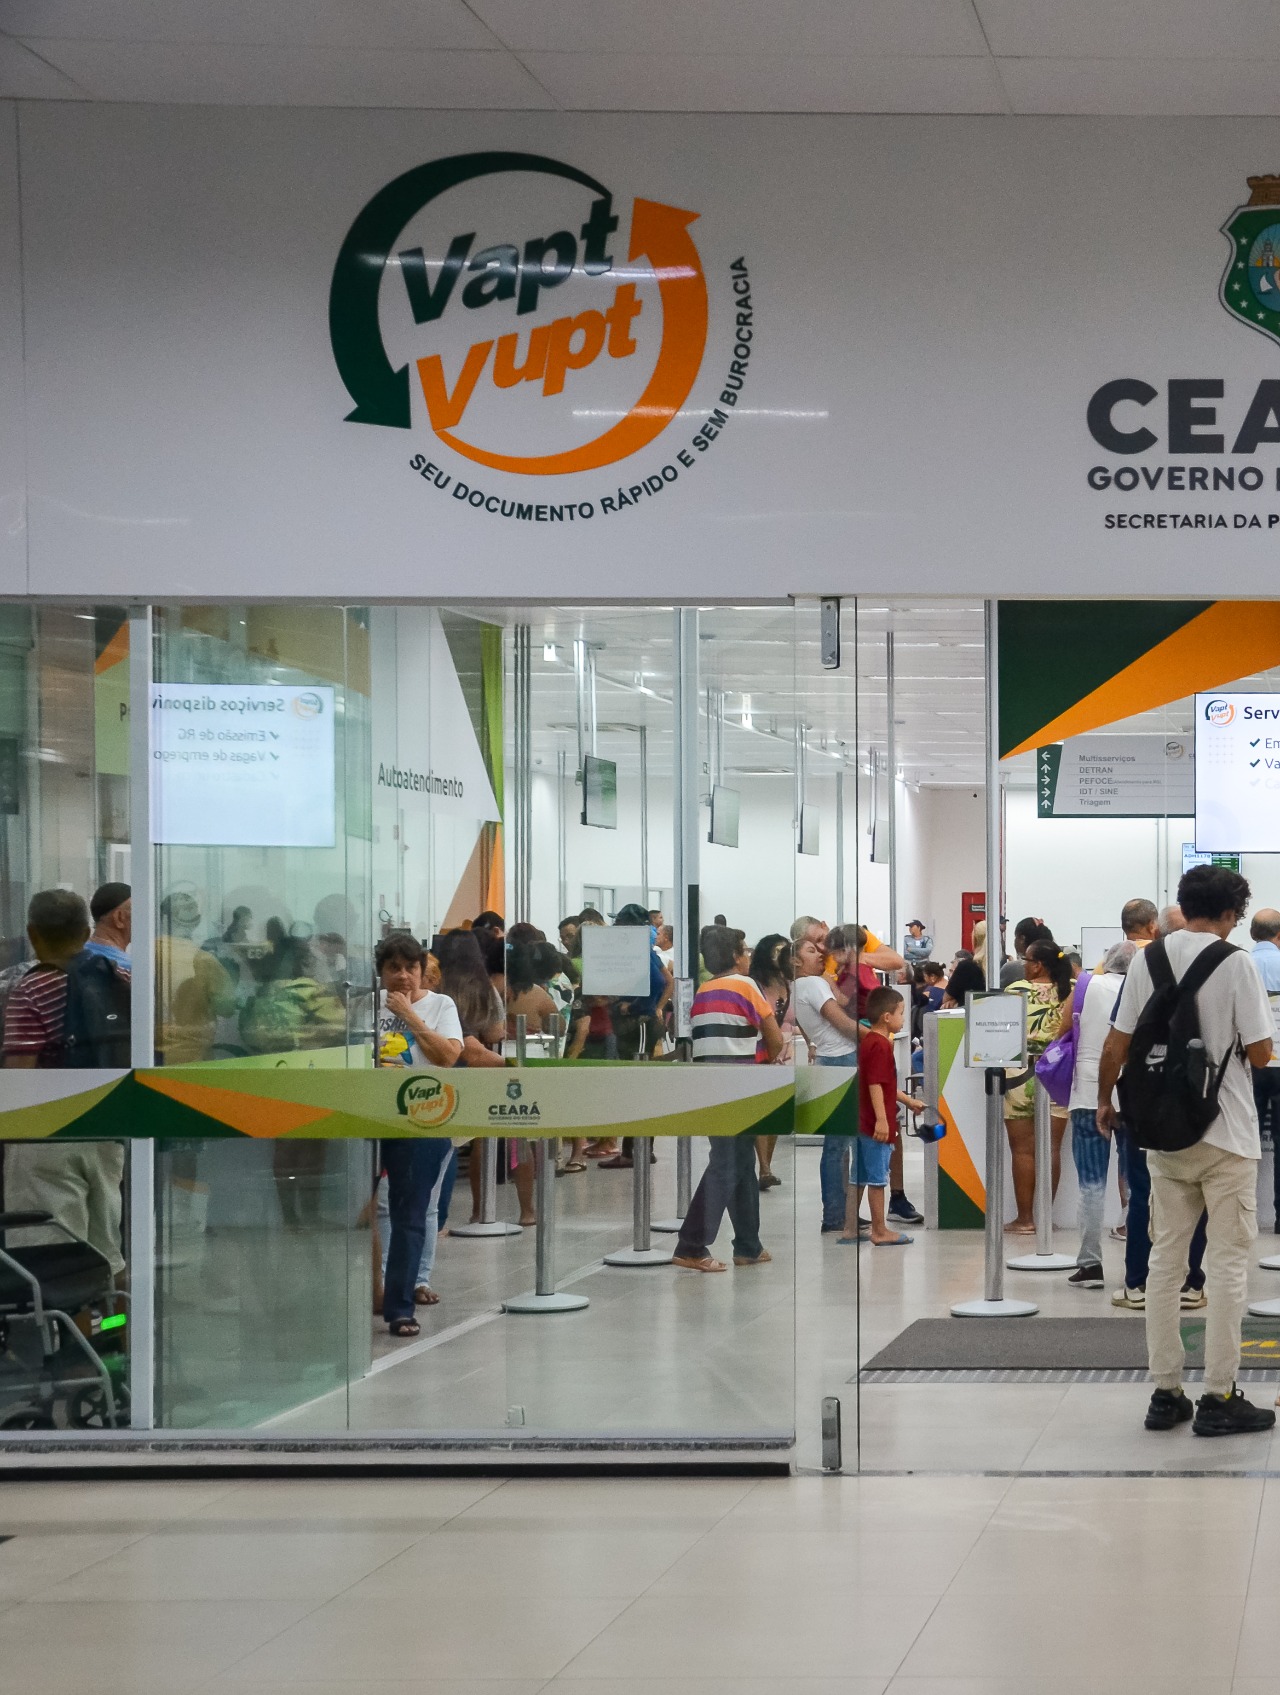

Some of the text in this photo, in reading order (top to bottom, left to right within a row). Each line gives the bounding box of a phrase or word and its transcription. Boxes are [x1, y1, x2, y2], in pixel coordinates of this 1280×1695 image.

[399, 195, 619, 325] Vapt
[416, 282, 643, 431] Vupt
[409, 256, 754, 522] SEU DOCUMENTO RÁPIDO E SEM BUROCRACIA
[1087, 466, 1264, 492] GOVERNO
[1104, 514, 1228, 529] SECRETARIA
[1233, 514, 1262, 529] DA
[1079, 754, 1136, 762] Multisserviços
[378, 762, 464, 798] Autoatendimento
[1079, 777, 1112, 785] PEFOCE
[1080, 799, 1111, 807] Triagem
[408, 1082, 442, 1100] Vapt
[488, 1101, 541, 1115] CEARÁ
